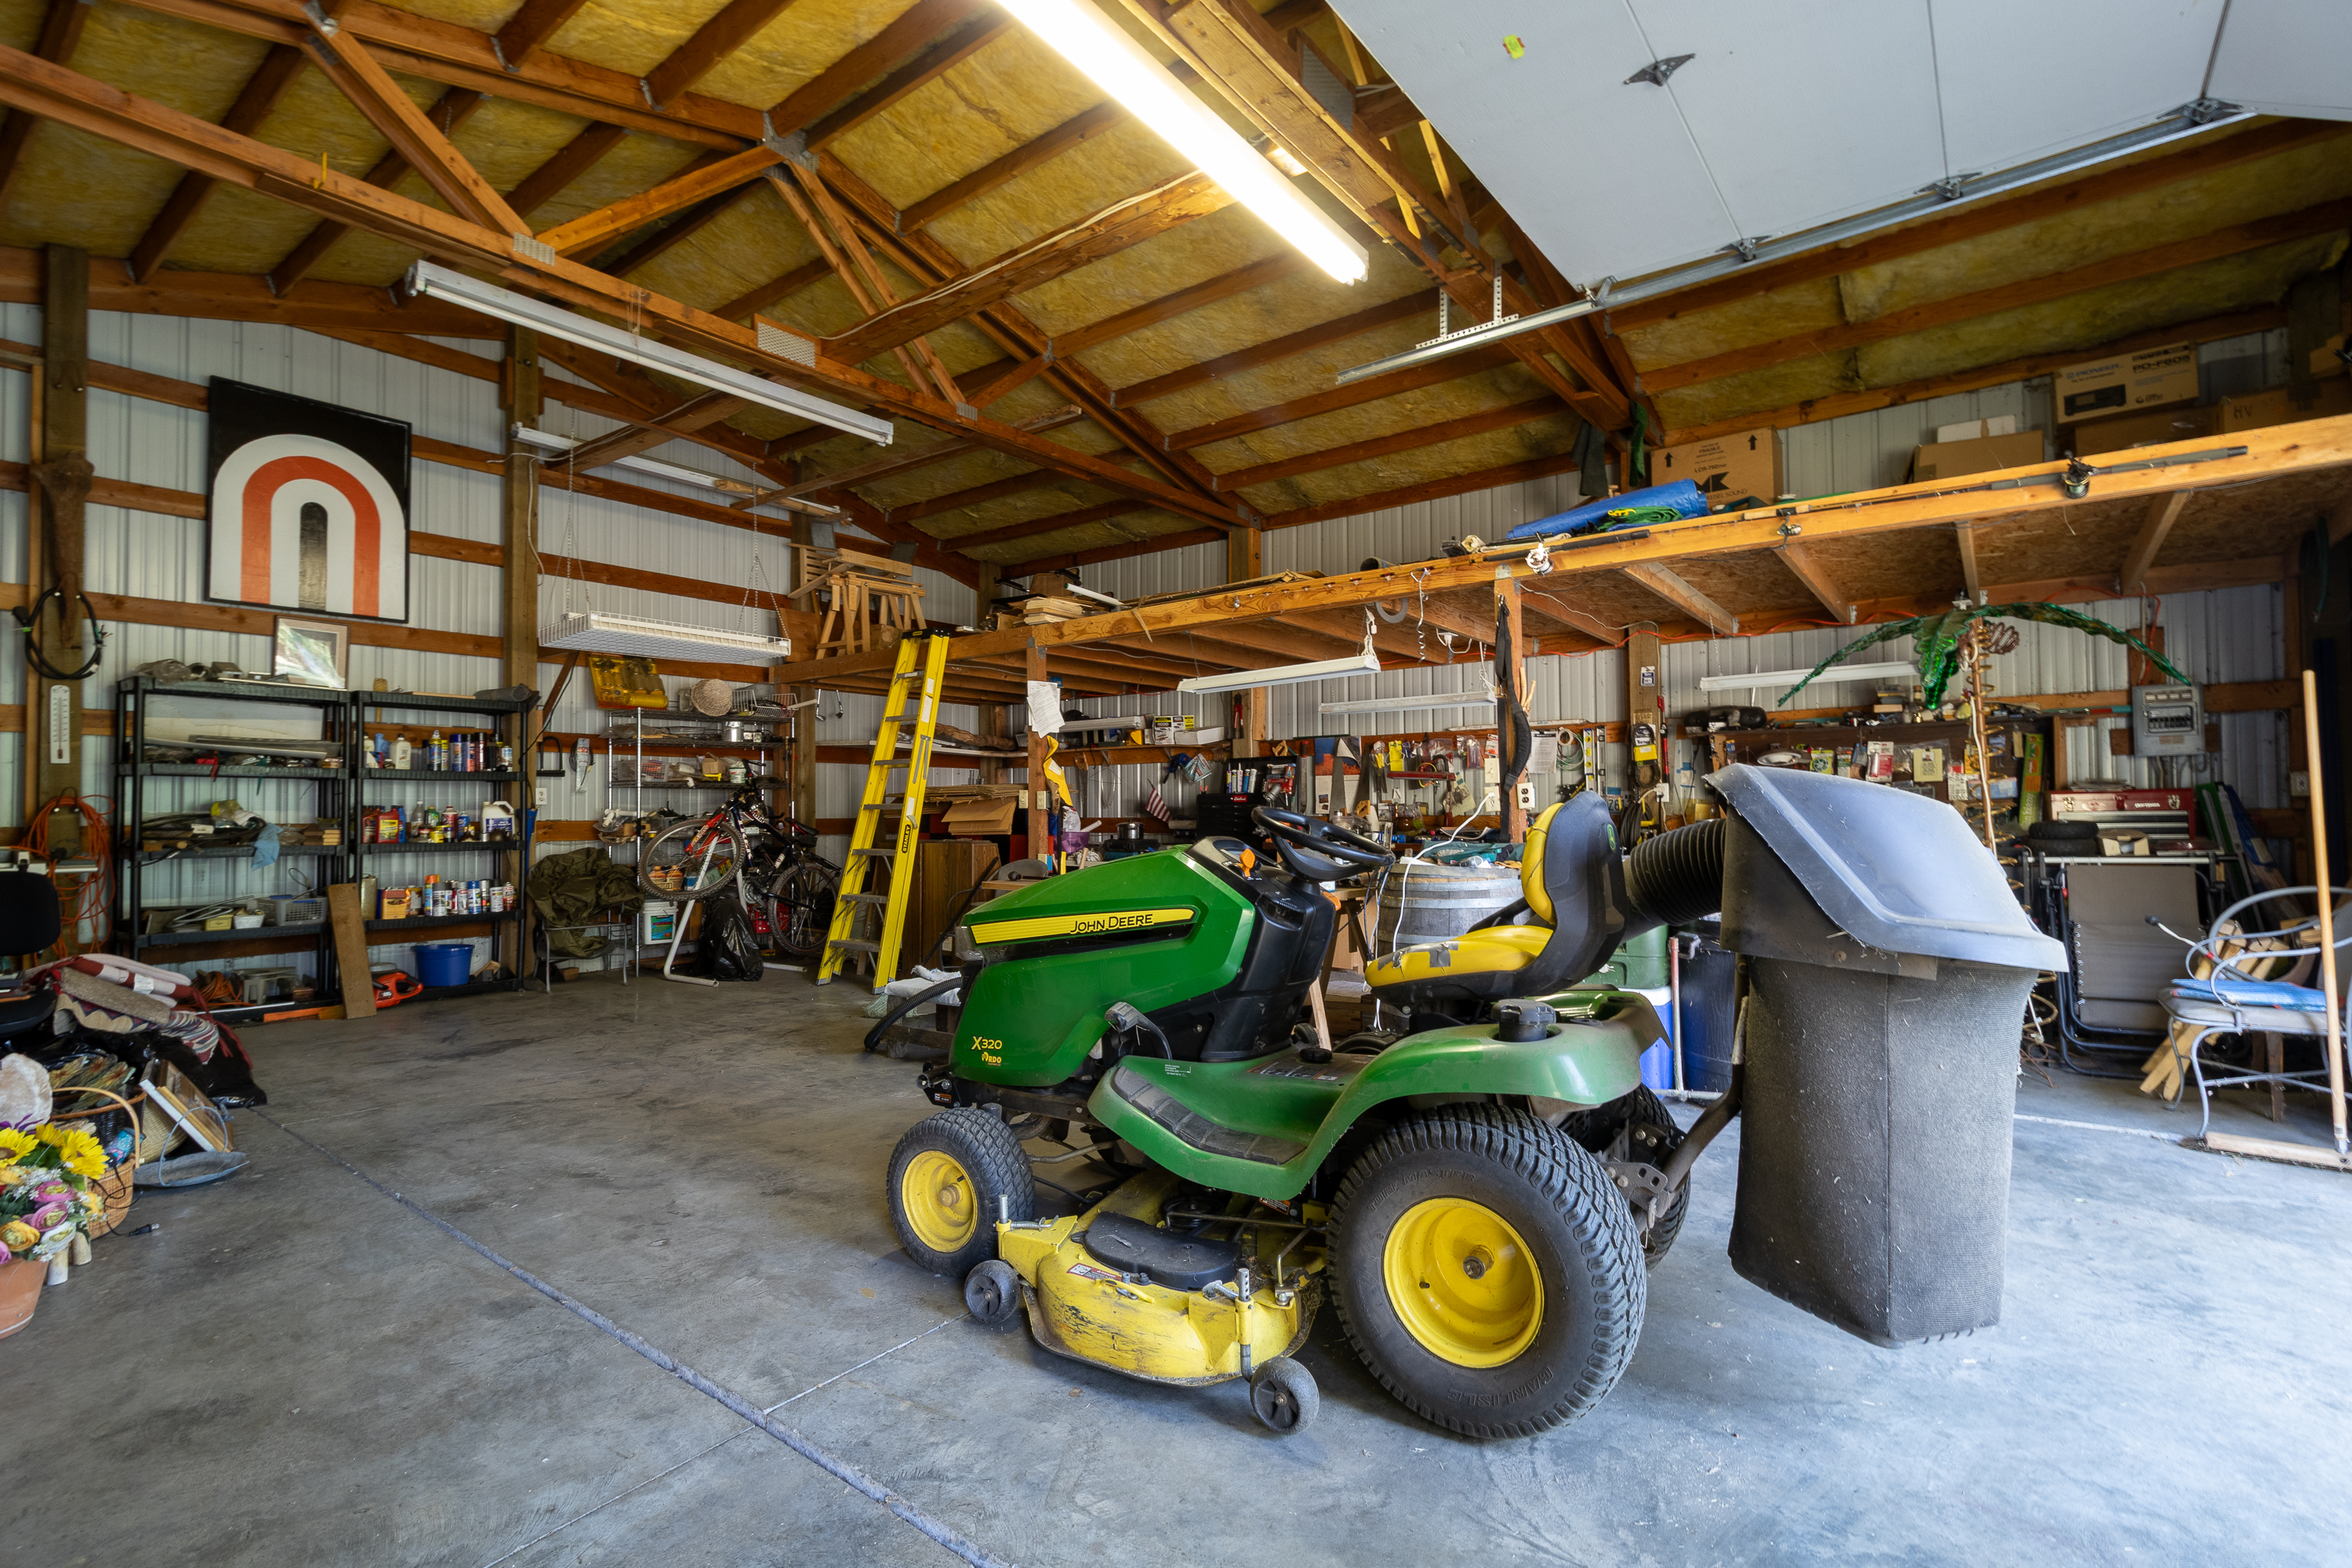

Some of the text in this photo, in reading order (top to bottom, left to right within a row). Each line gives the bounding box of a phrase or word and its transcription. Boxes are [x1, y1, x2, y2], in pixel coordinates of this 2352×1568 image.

[902, 826, 911, 852] STANLEY
[1070, 913, 1153, 934] JOHN DEERE
[971, 1036, 1003, 1051] X320
[1402, 1168, 1475, 1185] MASTER
[1446, 1366, 1554, 1406] CARLISLE
